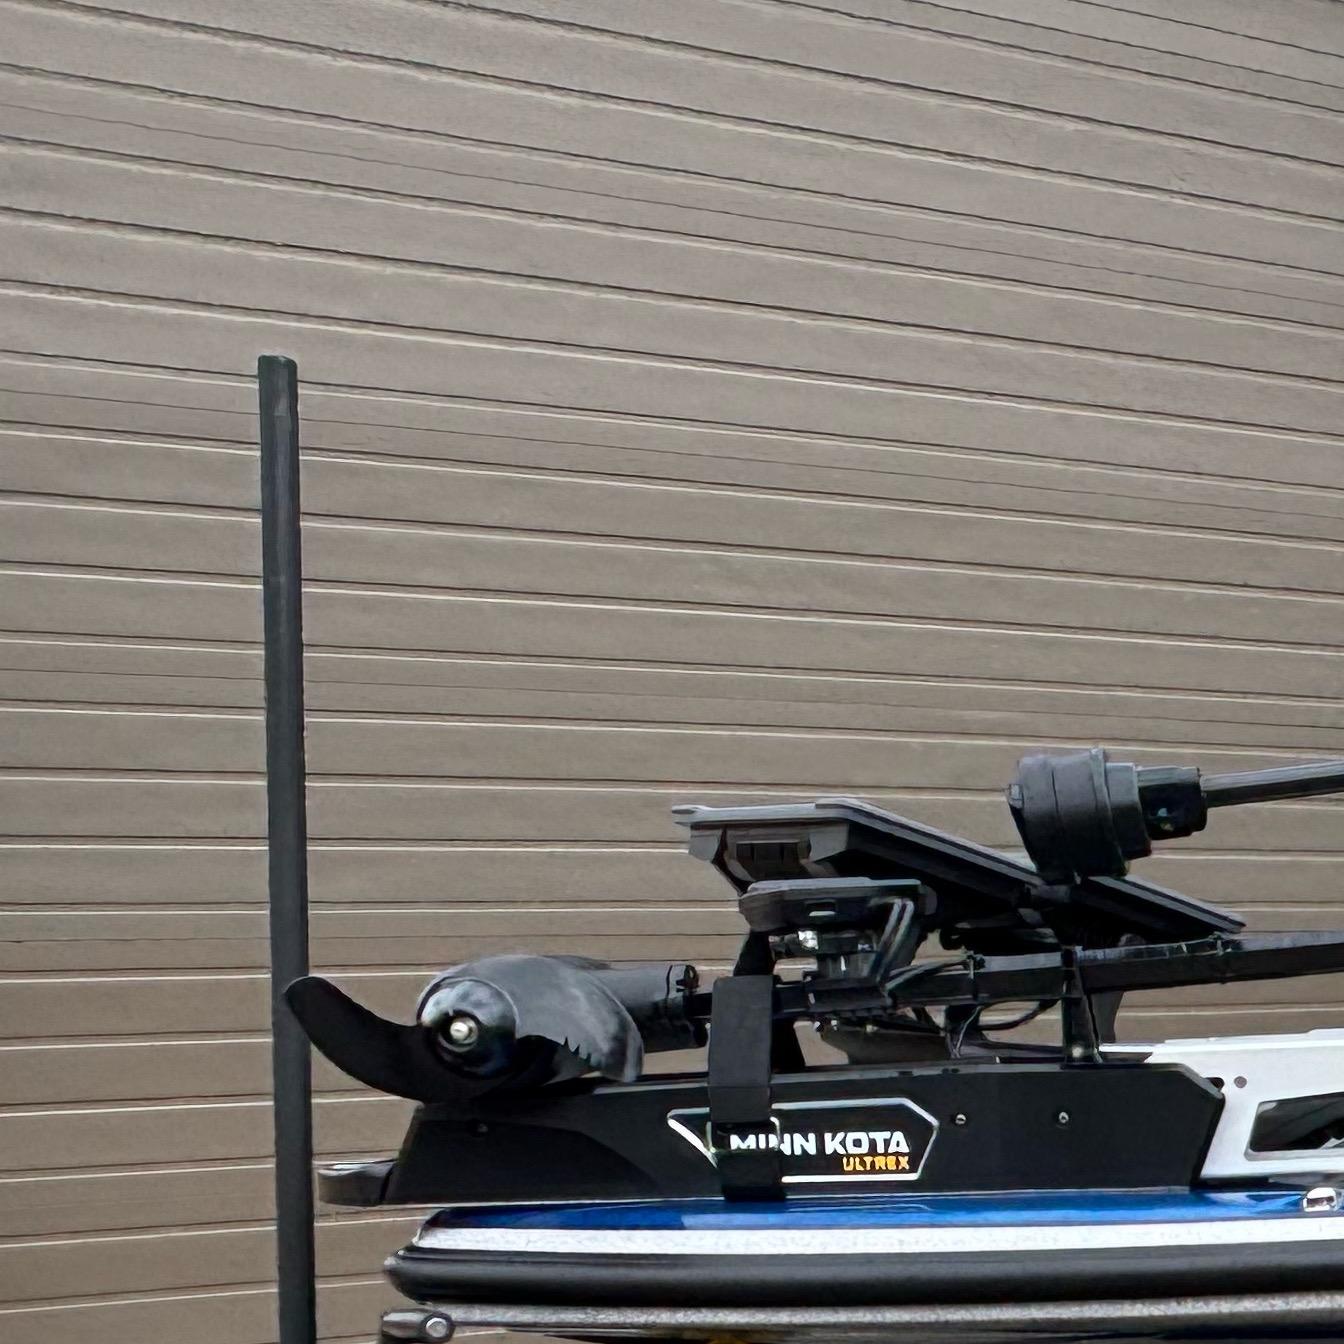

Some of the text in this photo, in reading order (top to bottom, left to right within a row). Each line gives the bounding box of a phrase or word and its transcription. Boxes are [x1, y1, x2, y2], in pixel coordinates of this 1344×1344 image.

[730, 1131, 910, 1156] MINN KOTA
[842, 1155, 910, 1172] ULTREX
